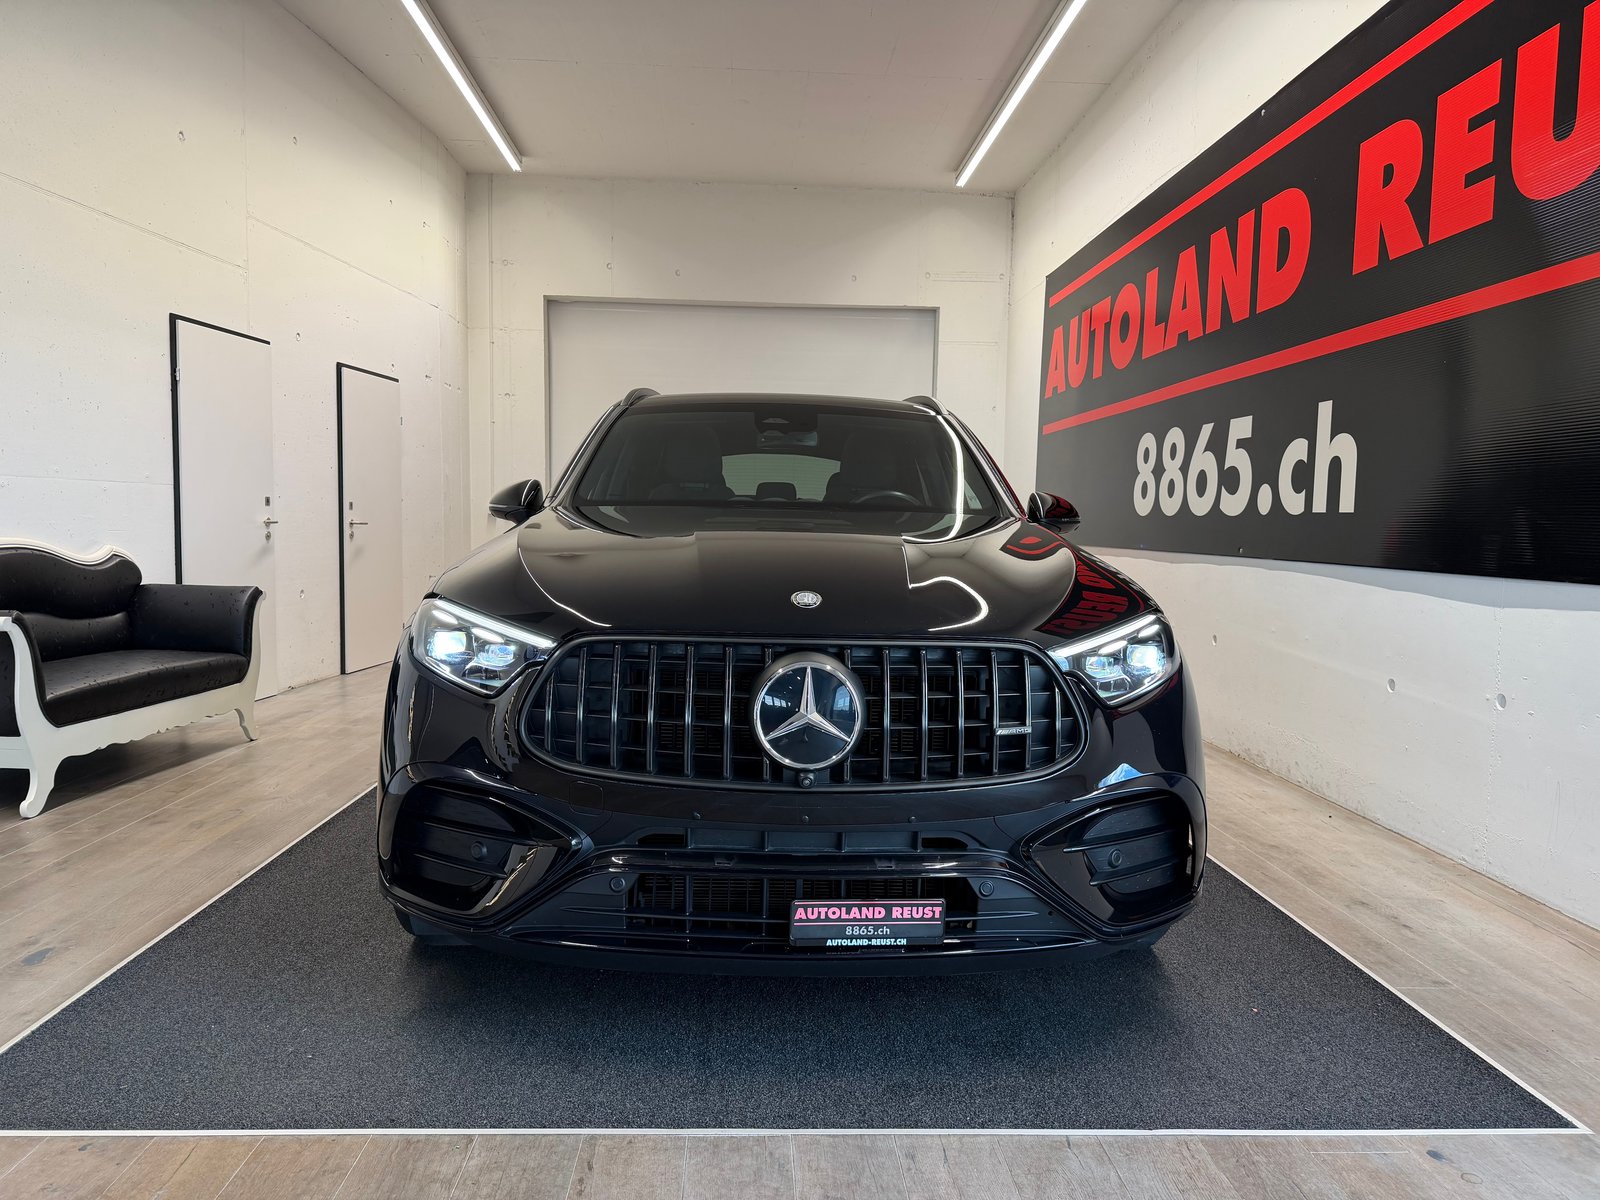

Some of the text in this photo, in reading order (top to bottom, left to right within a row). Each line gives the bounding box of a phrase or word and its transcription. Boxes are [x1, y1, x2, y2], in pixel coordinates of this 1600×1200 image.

[1044, 187, 1312, 400] AUTOLAND
[1133, 400, 1358, 517] 8865.ch
[794, 906, 943, 920] AUTOLAND REUST
[845, 925, 890, 935] 8865.ch
[826, 938, 907, 946] AUTOLAND-REUST.CH
